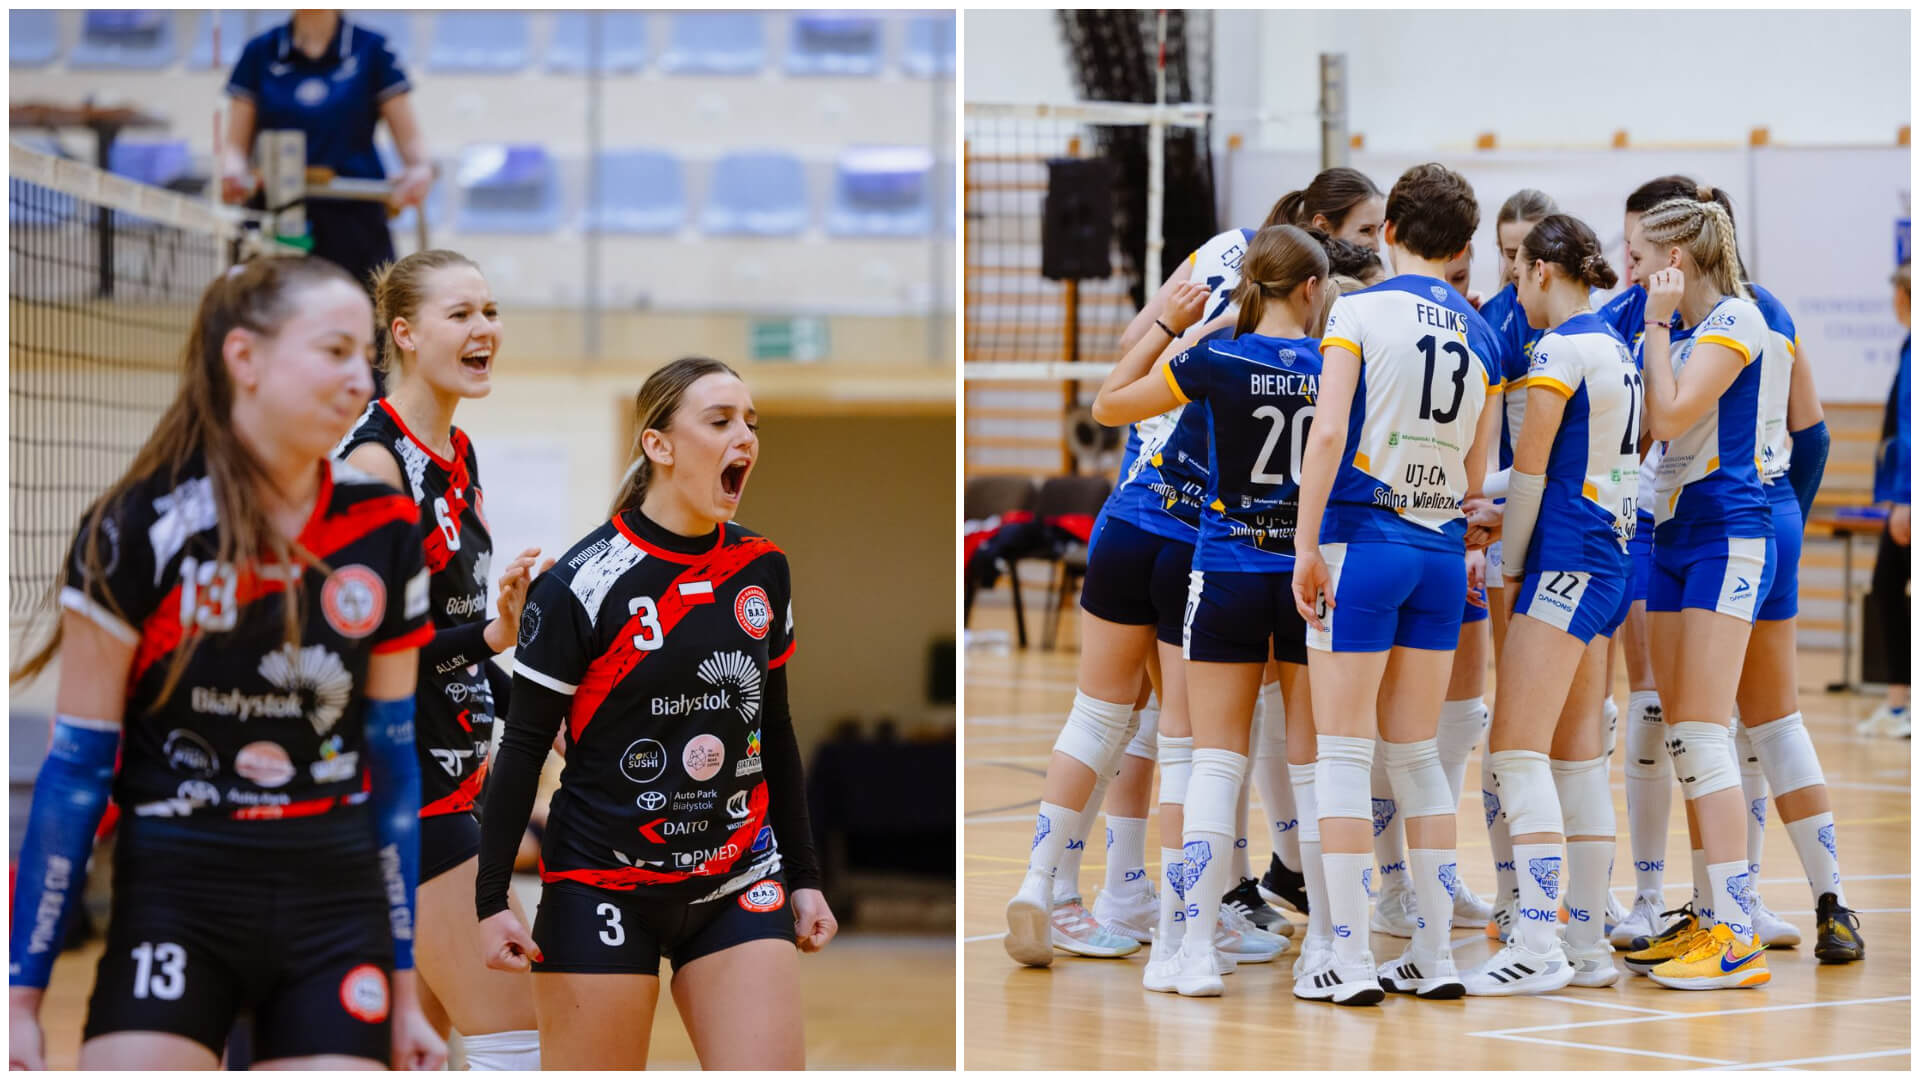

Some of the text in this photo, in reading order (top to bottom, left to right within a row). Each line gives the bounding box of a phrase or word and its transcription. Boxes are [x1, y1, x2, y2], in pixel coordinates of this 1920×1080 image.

[1416, 303, 1468, 334] FELIKS
[1250, 373, 1320, 397] BIERCZA
[1416, 334, 1470, 424] 13
[1405, 463, 1446, 488] UJ-CM
[1373, 487, 1408, 509] Solna
[433, 497, 461, 551] 6
[567, 539, 612, 571] PROUDEST
[180, 556, 238, 632] 13
[1538, 593, 1573, 613] DAMONS
[628, 596, 664, 651] 3
[651, 689, 731, 716] Białystok
[628, 760, 658, 768] SUSHI
[672, 801, 713, 812] Białystok
[674, 789, 718, 800] Auto Park
[663, 820, 708, 835] DAITO
[596, 902, 626, 947] 3
[131, 941, 188, 1001] 13
